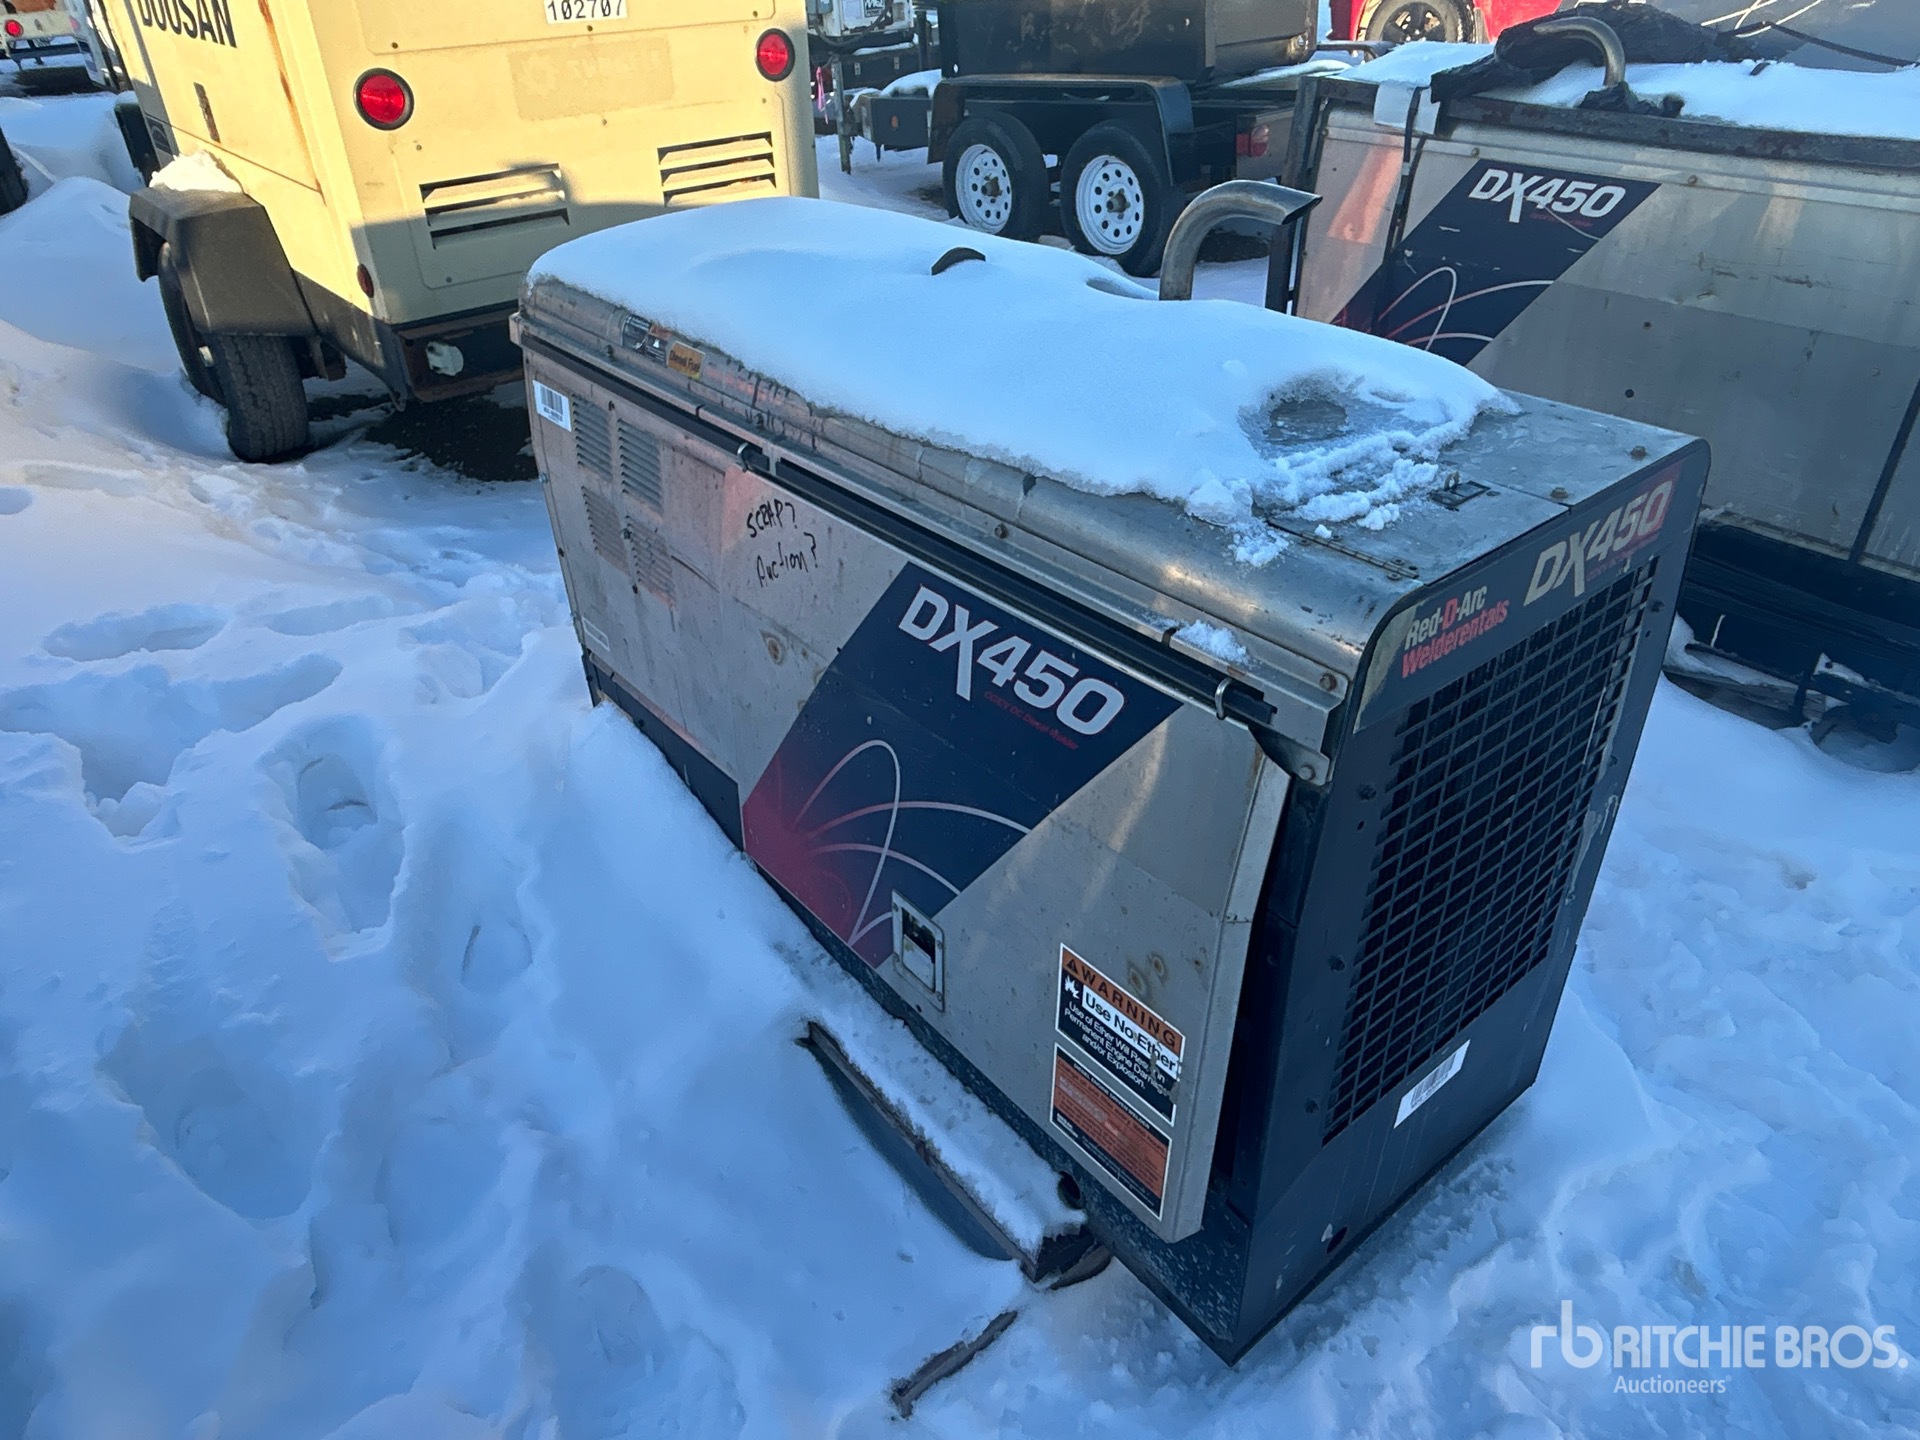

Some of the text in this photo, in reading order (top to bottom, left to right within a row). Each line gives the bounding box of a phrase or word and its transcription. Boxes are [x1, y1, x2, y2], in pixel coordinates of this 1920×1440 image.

[548, 0, 623, 20] 102707
[1468, 168, 1626, 223] DX450
[747, 499, 798, 538] SCRAP?
[1524, 481, 1673, 607] DX450
[757, 532, 818, 588] Auction?
[1402, 600, 1509, 679] Welderentals
[1404, 585, 1487, 650] Red-D-Arc
[898, 585, 1125, 735] DX450
[1064, 1007, 1104, 1046] Permanent
[1105, 1040, 1132, 1067] Engine
[1069, 1001, 1084, 1018] Use
[1085, 1016, 1093, 1026] of
[1093, 1021, 1114, 1042] Ether
[1115, 1037, 1130, 1056] Will
[1081, 965, 1176, 1049] WARNING
[1086, 992, 1176, 1070] Use No Ether
